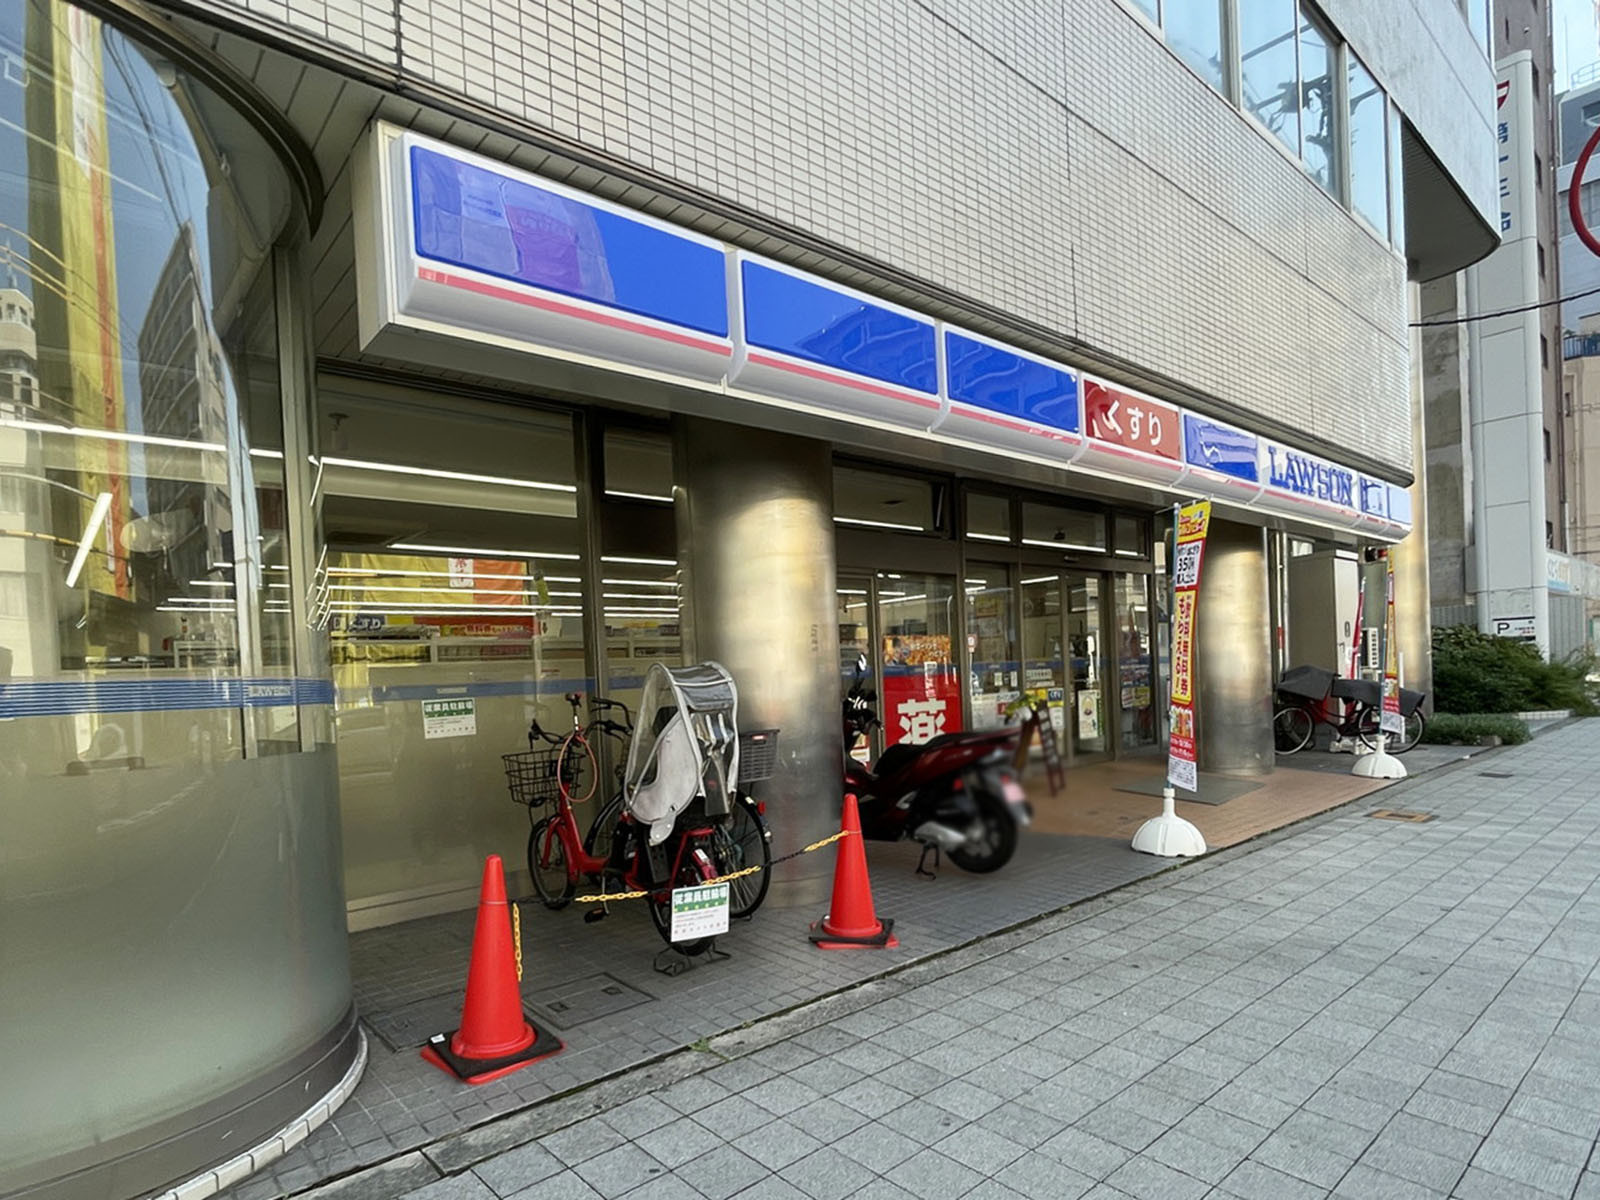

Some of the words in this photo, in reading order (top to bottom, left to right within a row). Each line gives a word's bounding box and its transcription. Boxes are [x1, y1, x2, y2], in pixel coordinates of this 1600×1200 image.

[1106, 400, 1162, 446] くすり
[1268, 445, 1354, 508] LAWSON
[1497, 622, 1510, 635] P
[897, 697, 947, 746] 薬
